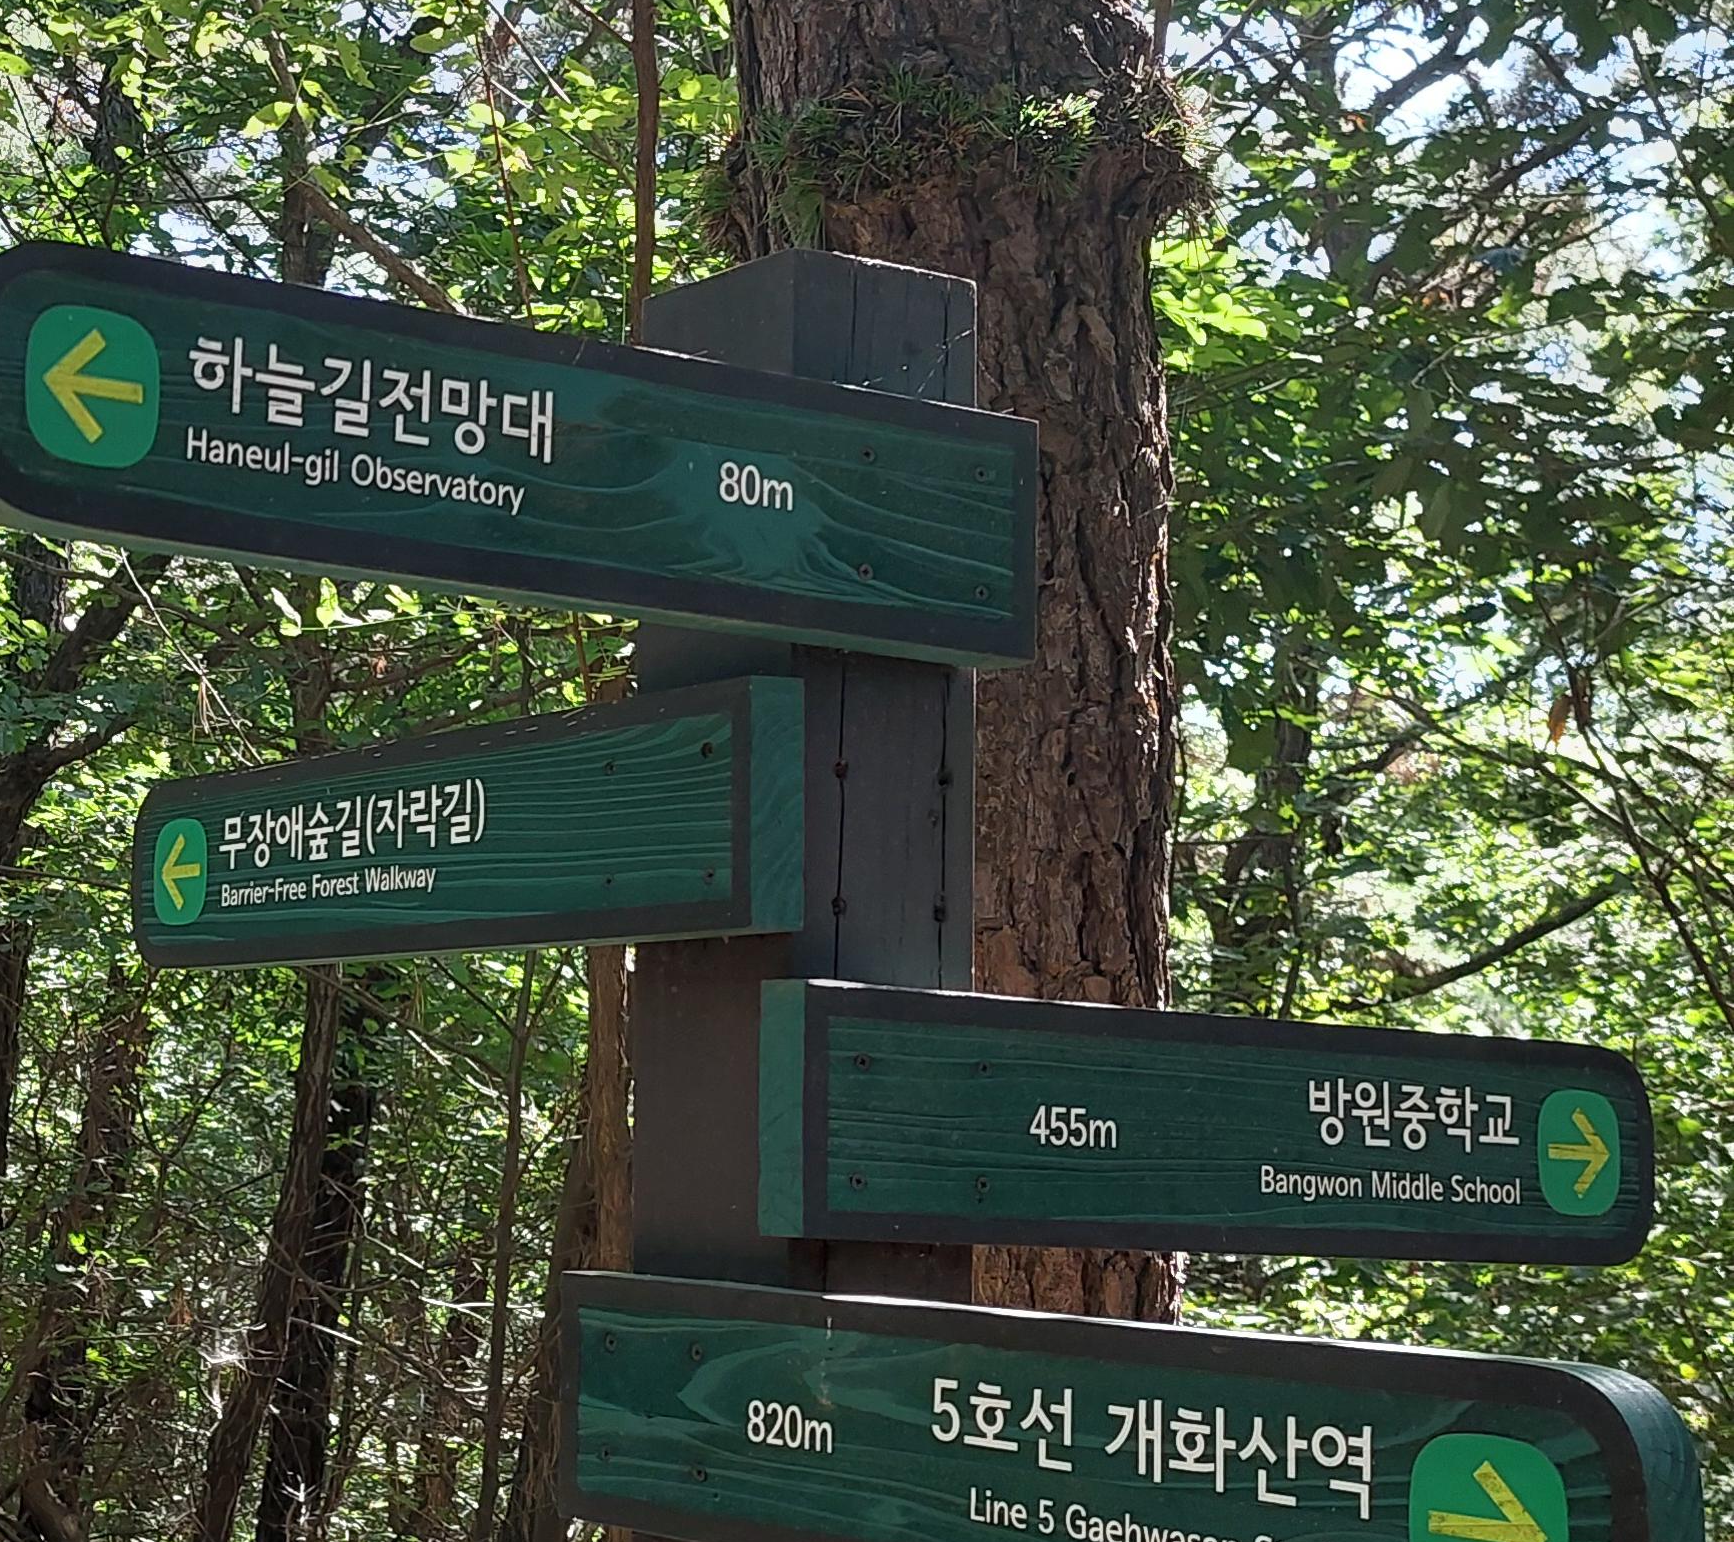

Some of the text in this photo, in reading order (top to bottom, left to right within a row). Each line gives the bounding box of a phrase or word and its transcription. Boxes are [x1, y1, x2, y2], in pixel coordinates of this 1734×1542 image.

[189, 337, 554, 463] 하늘길전망대
[187, 426, 525, 516] Haneul-gil Observatory
[719, 461, 793, 511] 80m
[219, 778, 485, 870] 무장애숲길(자락길)
[221, 865, 436, 907] Barrier-Free Forest Walkway
[1029, 1105, 1117, 1148] 455m
[1309, 1078, 1520, 1153] 방원중학교
[1261, 1165, 1520, 1204] Bangwon Middle School
[747, 1400, 832, 1454] 820m
[931, 1377, 1372, 1520] 5호선 개화산역
[970, 1487, 1028, 1529] Line
[1038, 1499, 1055, 1534] 5
